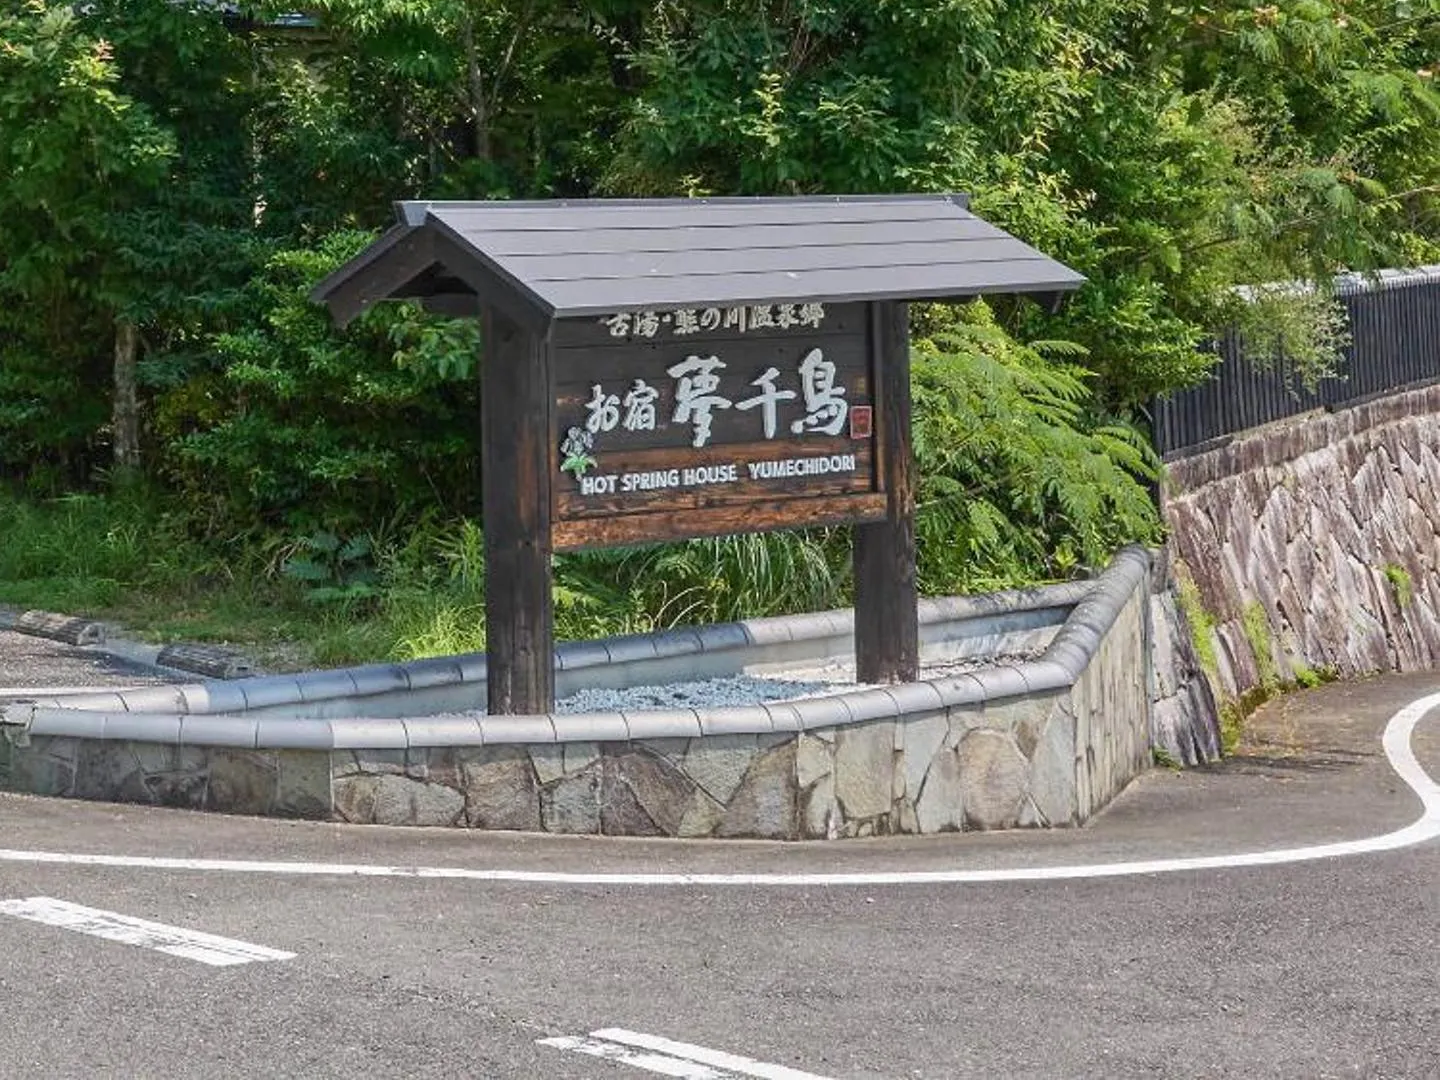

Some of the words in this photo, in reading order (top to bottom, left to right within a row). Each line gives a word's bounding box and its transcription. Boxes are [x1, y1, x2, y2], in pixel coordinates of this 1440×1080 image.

[581, 477, 617, 494] HOT
[621, 470, 679, 491] SPRING
[684, 465, 737, 486] HOUSE
[749, 456, 855, 480] YUMECHIDORI
